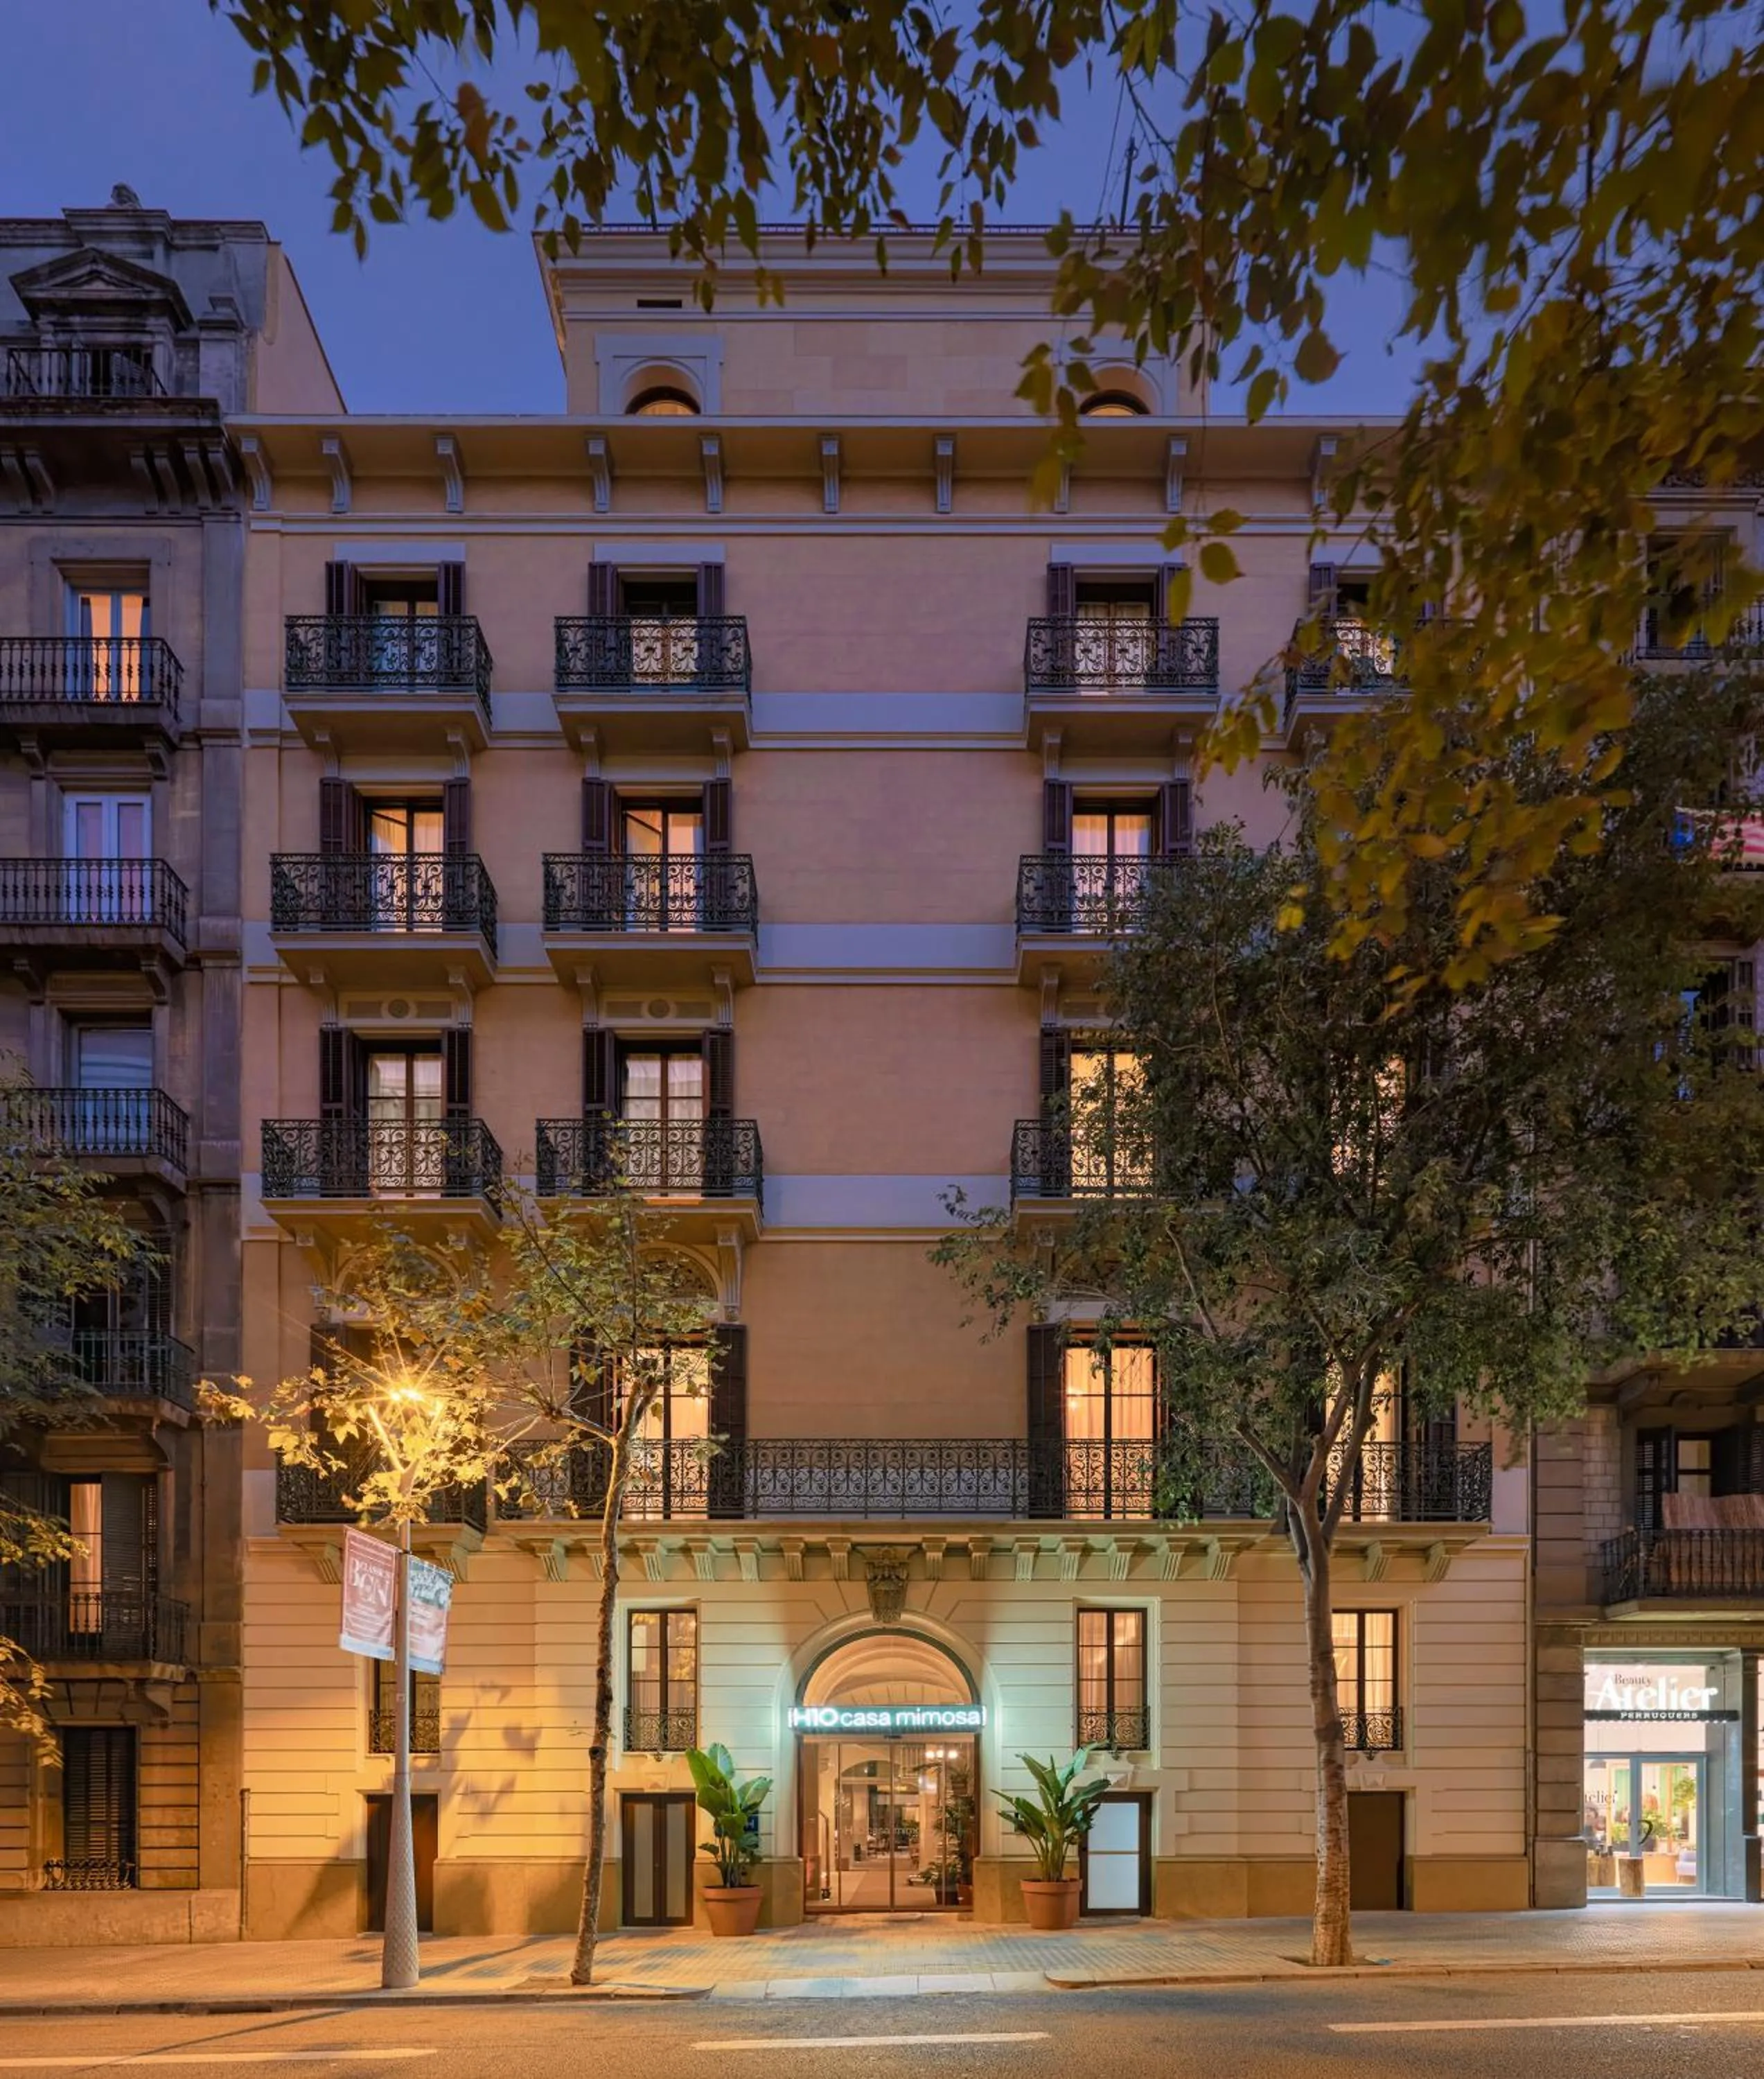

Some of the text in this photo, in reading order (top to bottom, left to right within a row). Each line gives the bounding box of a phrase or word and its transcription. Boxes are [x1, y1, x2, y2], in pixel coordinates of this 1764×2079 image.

[1614, 1673, 1652, 1687] Beauty
[1587, 1676, 1718, 1710] Atelier
[896, 1708, 981, 1726] mimosa
[1621, 1711, 1698, 1719] PERRUQUERS
[1584, 1790, 1618, 1804] telier
